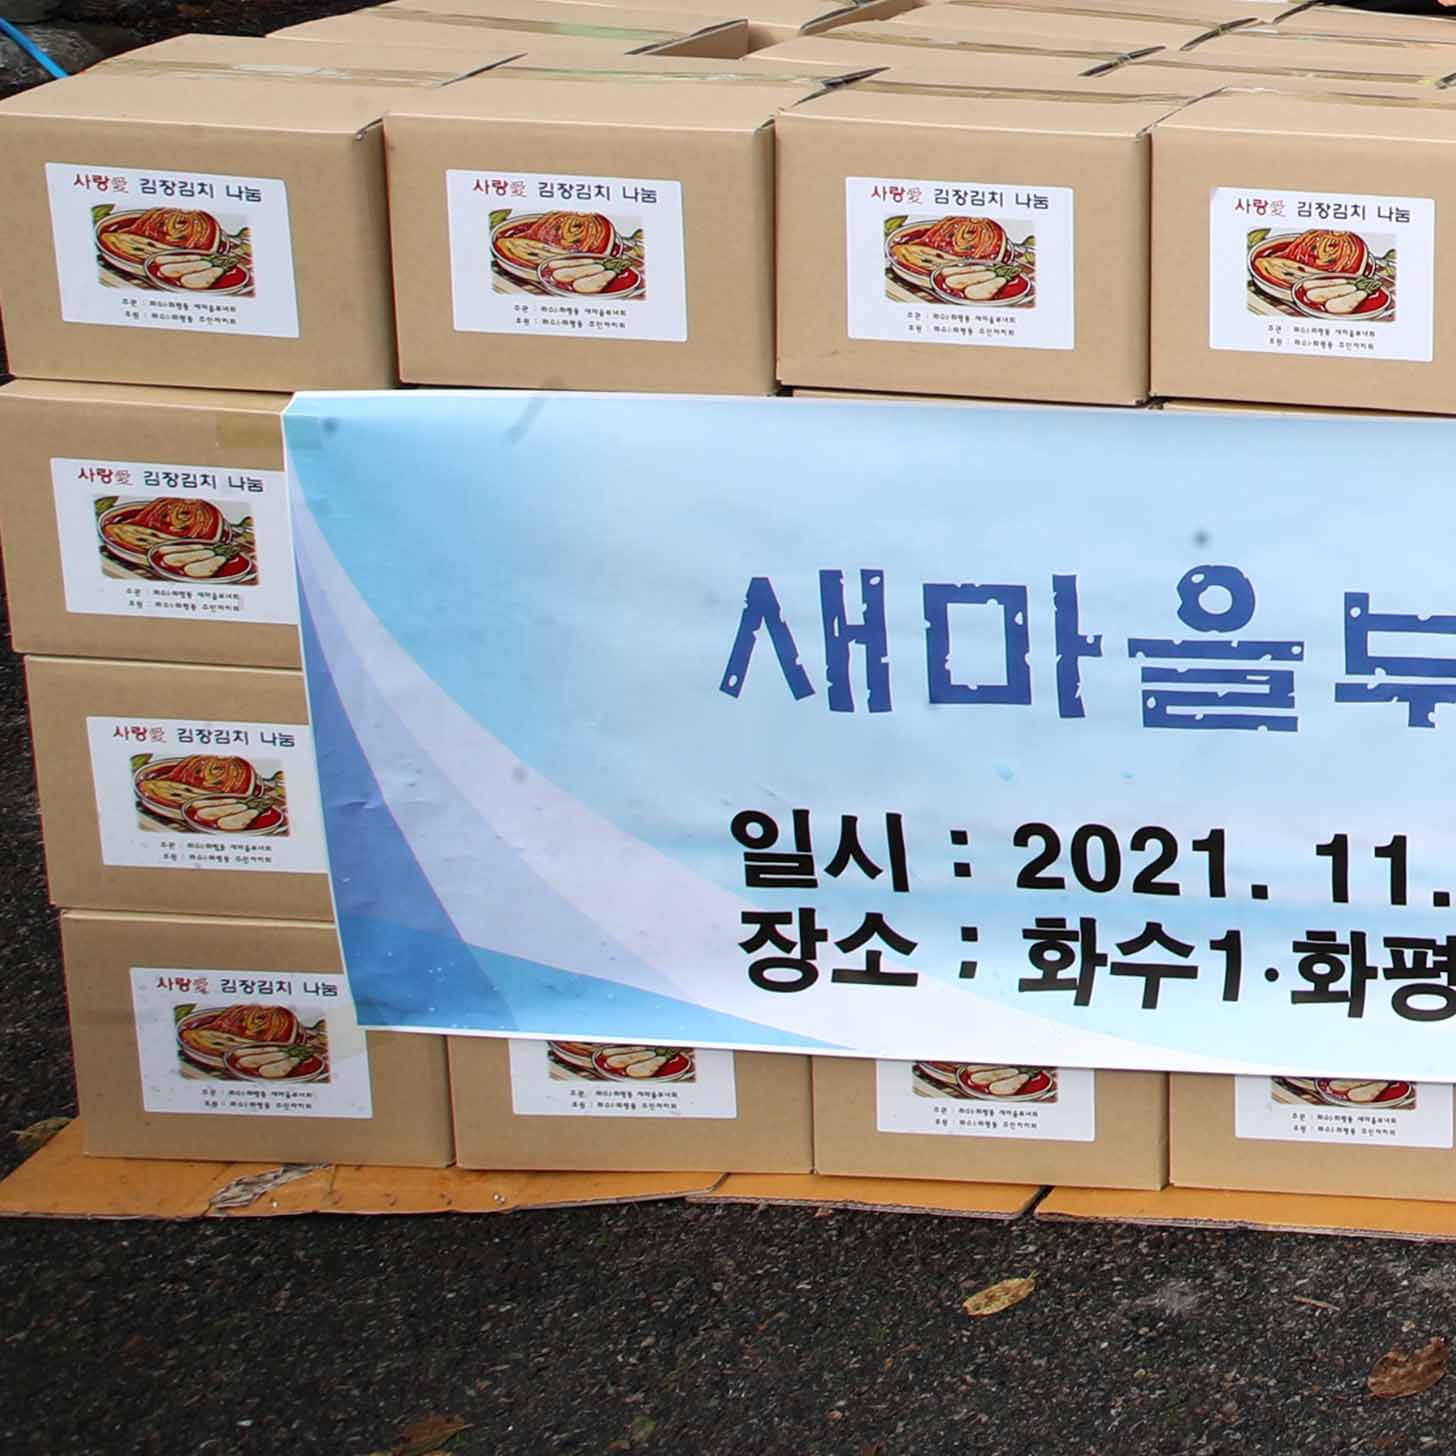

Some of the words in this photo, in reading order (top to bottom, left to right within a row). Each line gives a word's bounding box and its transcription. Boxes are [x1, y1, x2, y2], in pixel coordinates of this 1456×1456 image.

[139, 177, 215, 200] 김장김치
[225, 184, 262, 203] 나눔
[537, 181, 611, 202] 김장김치
[621, 185, 657, 204] 나눔
[933, 187, 1004, 209] 김장김치
[1015, 192, 1049, 210] 나눔
[1297, 200, 1366, 221] 김장김치
[1377, 205, 1411, 224] 나눔
[143, 470, 217, 490] 김장김치
[227, 475, 264, 493] 나눔
[176, 727, 249, 746] 김장김치
[259, 731, 296, 748] 나눔
[729, 808, 909, 896] 일시
[1012, 822, 1270, 904] 2021.
[1314, 832, 1453, 909] 11.
[737, 905, 919, 994] 장소
[219, 978, 293, 996] 김장김치
[303, 981, 338, 997] 나눔
